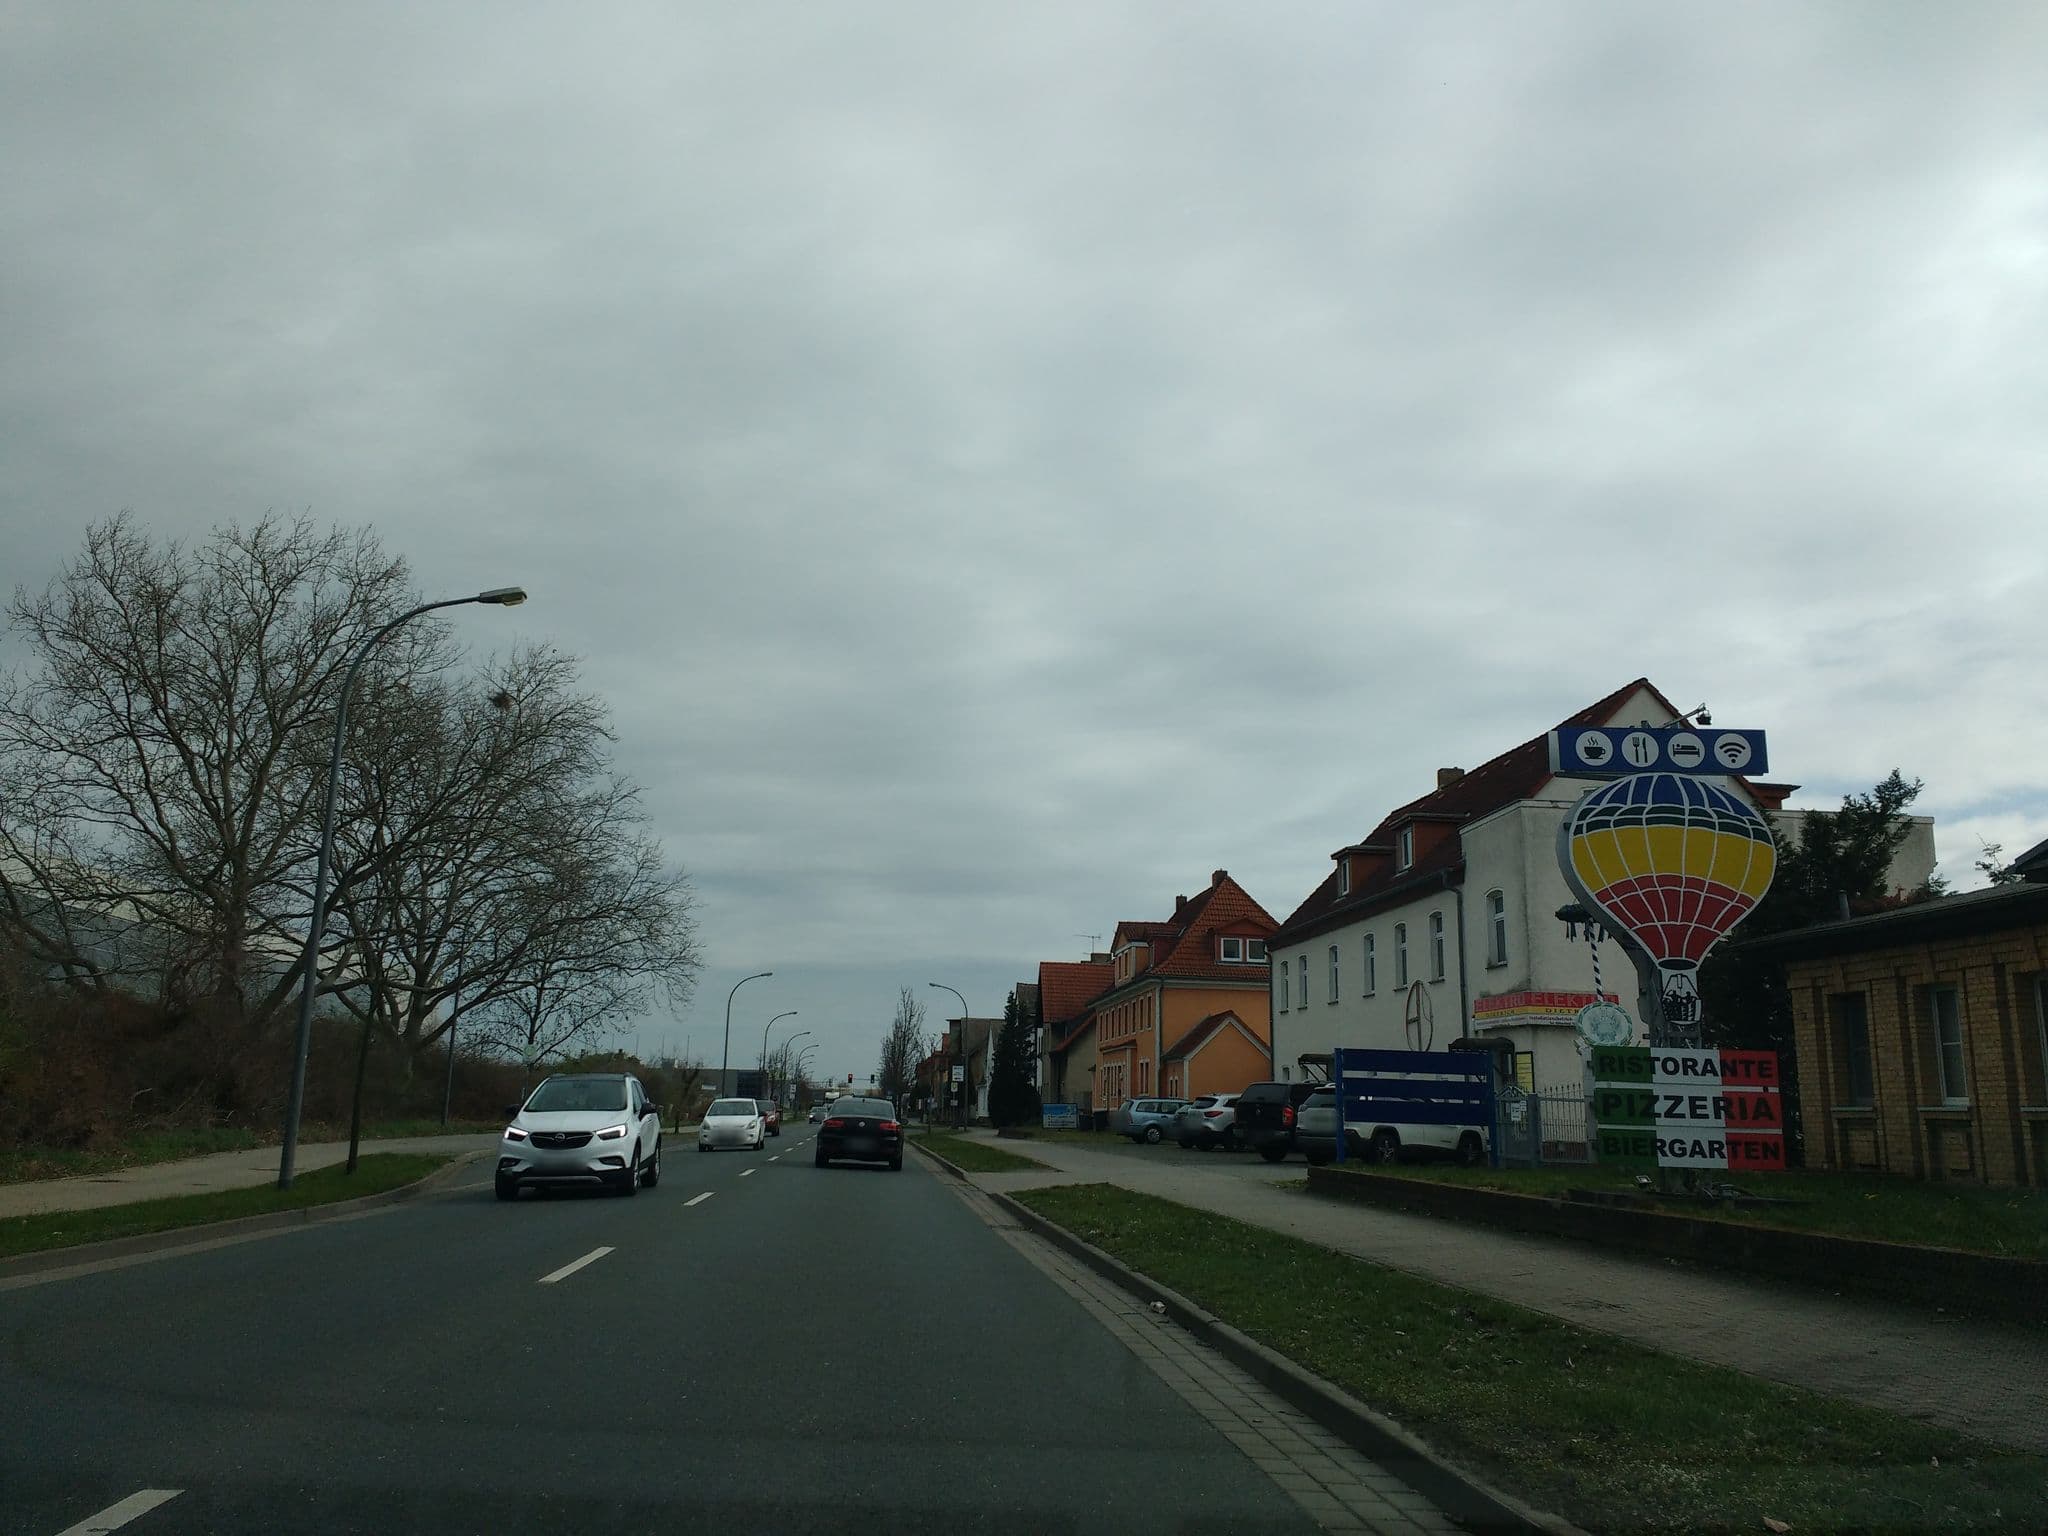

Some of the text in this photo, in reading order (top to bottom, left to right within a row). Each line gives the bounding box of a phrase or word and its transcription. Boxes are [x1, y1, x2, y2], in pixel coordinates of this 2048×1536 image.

[1599, 1055, 1774, 1079] RISTORANTE
[1601, 1093, 1776, 1121] PIZZERIA
[1603, 1135, 1781, 1160] BIERGARTEN
